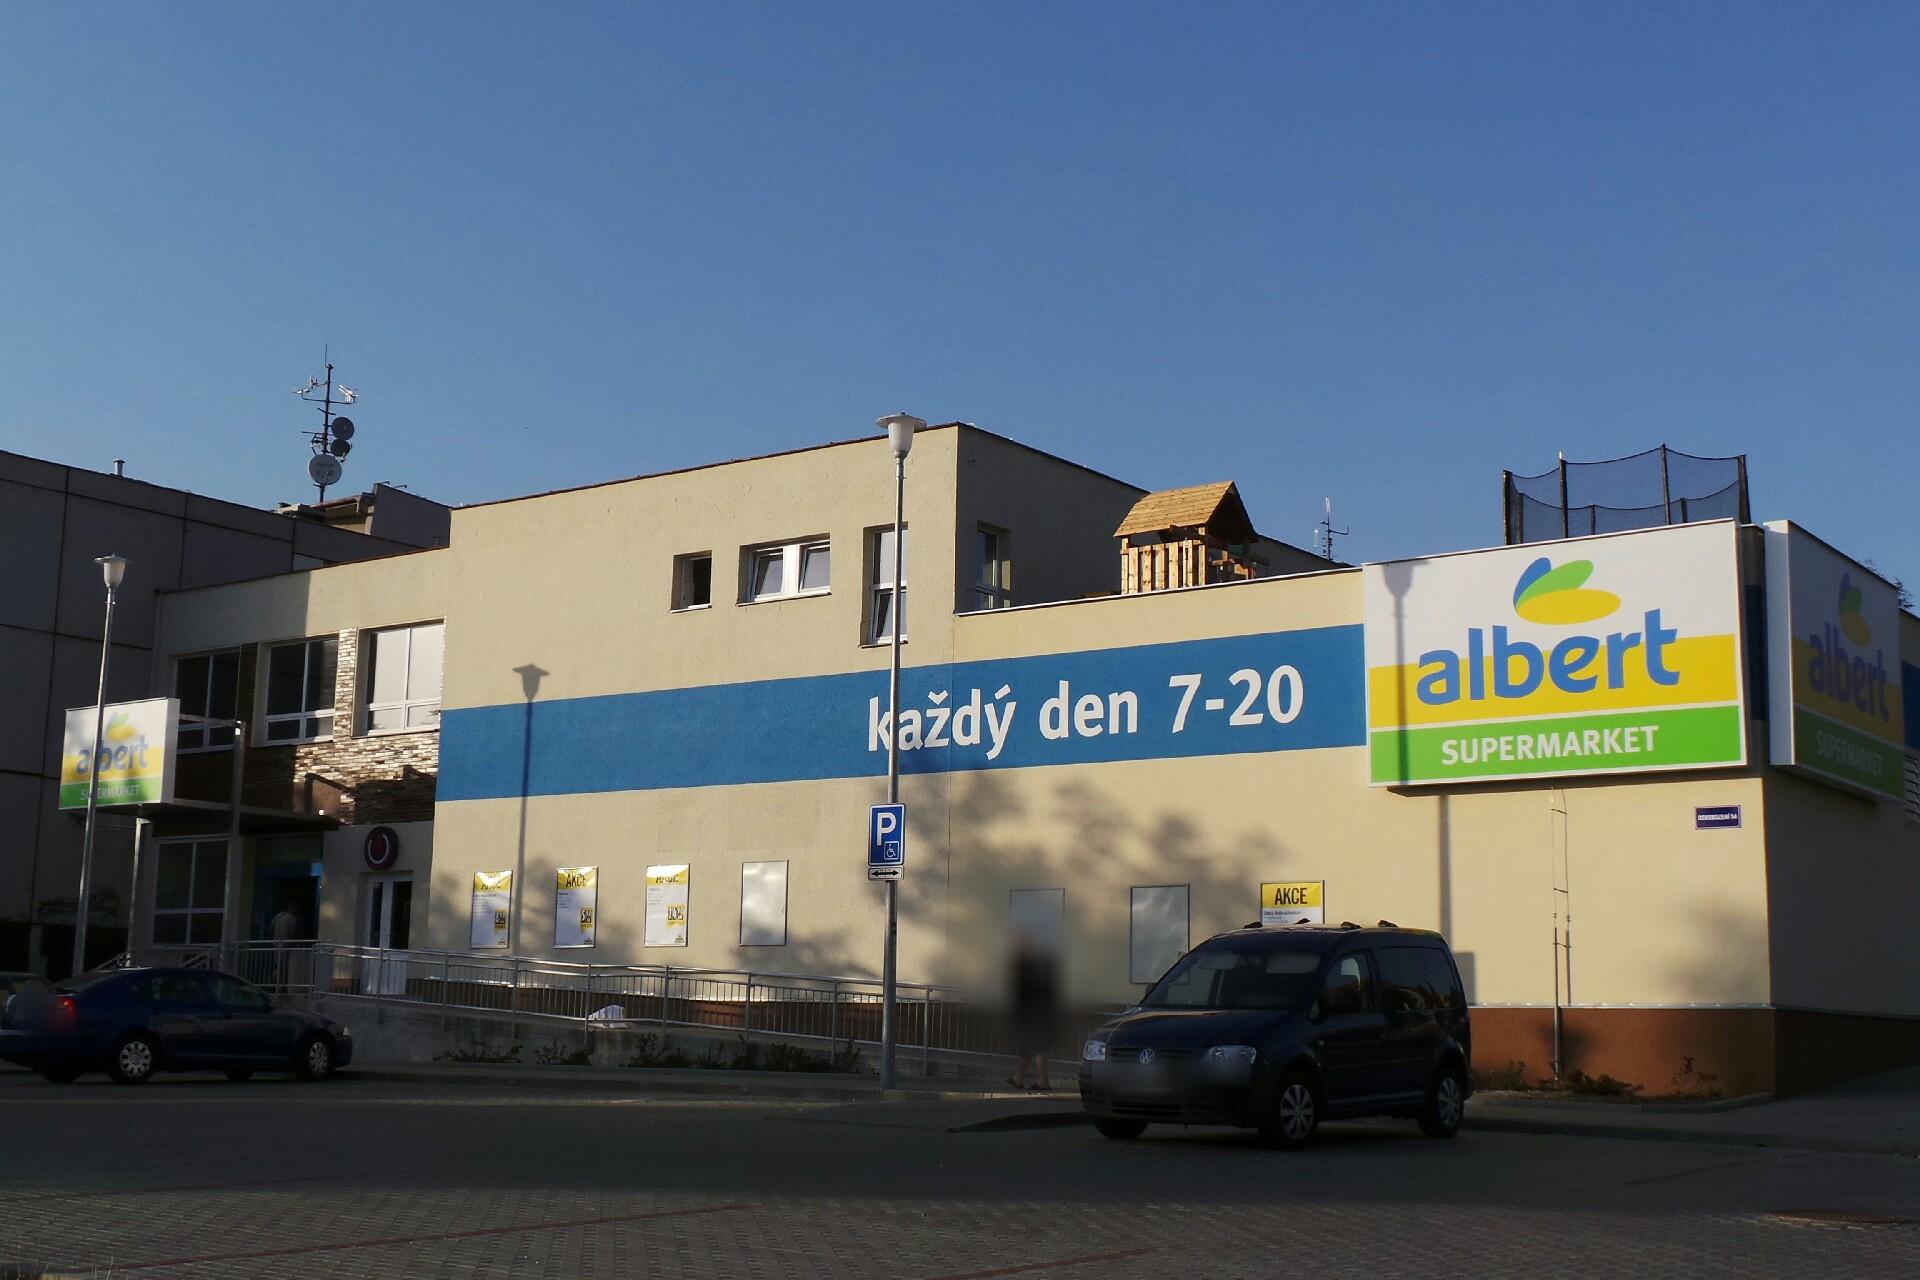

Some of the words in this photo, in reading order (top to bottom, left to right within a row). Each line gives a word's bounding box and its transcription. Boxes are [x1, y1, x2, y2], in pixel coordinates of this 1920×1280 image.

[1416, 608, 1680, 706] albert
[1809, 620, 1890, 722] albert
[868, 684, 1017, 760] každý
[1039, 680, 1138, 740] den
[1168, 664, 1304, 734] 7-20
[77, 736, 148, 773] abert
[1441, 725, 1659, 766] SUPERMARKET
[1816, 730, 1884, 776] SUPERMARKET
[876, 812, 897, 847] P
[1275, 887, 1308, 905] AKCE
